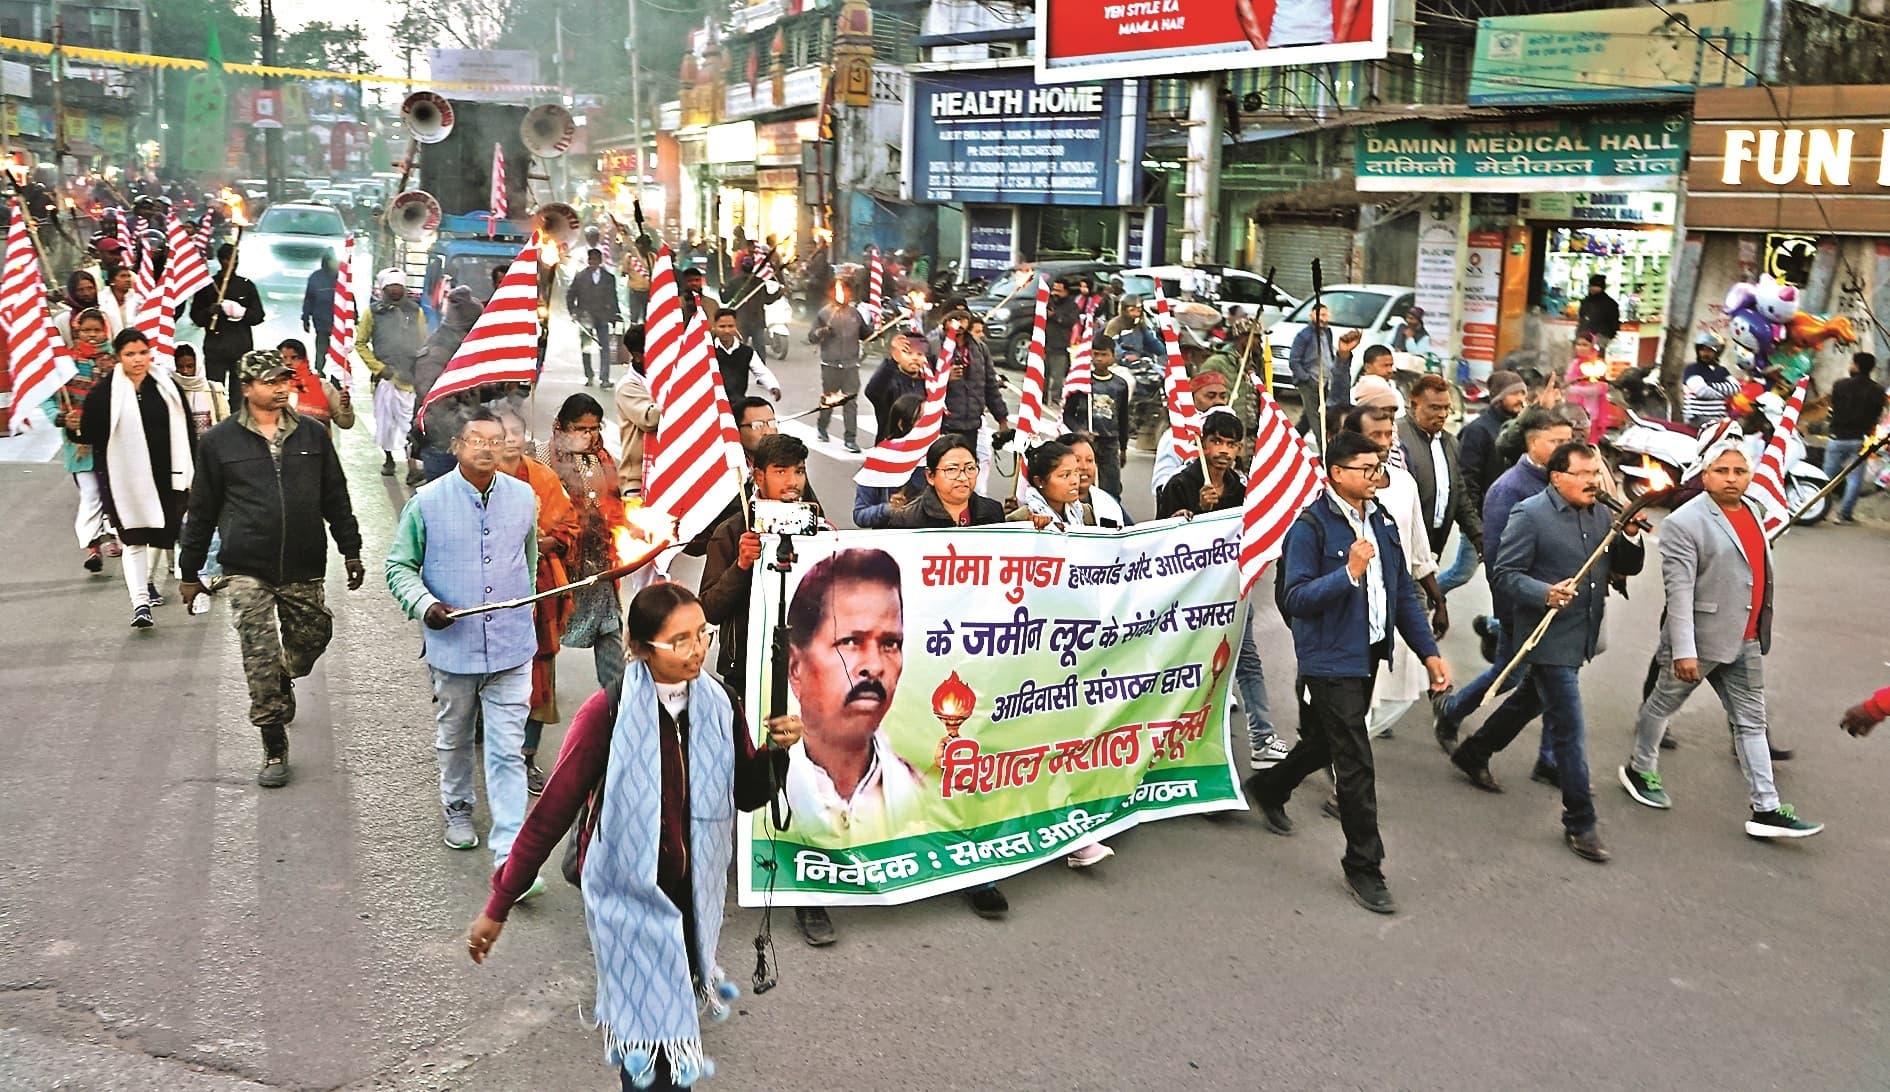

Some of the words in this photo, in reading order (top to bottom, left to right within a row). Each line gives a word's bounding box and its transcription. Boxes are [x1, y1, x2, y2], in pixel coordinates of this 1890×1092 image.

[1104, 5, 1125, 19] YEH
[1127, 1, 1160, 16] STYLE
[1162, 0, 1179, 12] KA
[1118, 20, 1160, 35] MAMLA
[931, 89, 1022, 116] HEALTH
[1028, 86, 1103, 113] HOME
[1367, 138, 1456, 154] DAMINI
[1466, 135, 1590, 153] MEDICAL
[1601, 134, 1679, 151] HALL
[1721, 128, 1856, 186] FUN
[1366, 156, 1456, 175] दामिनी
[1475, 155, 1594, 175] मेडीकल
[1614, 153, 1680, 173] हॉल
[1572, 206, 1616, 219] MEDICAL
[1619, 207, 1643, 220] HALL
[1590, 192, 1628, 205] DAMINI
[922, 543, 992, 587] सोमा
[999, 556, 1065, 604] मुण्डा
[1124, 552, 1152, 582] और
[926, 619, 954, 656] के
[961, 606, 1047, 657] जमीन
[1050, 619, 1101, 667] लूट
[1099, 616, 1119, 648] के
[1159, 600, 1178, 632] में
[1181, 600, 1237, 631] समस्त
[991, 674, 1078, 722] आदिवासी
[1083, 669, 1160, 706] संगठन
[1161, 664, 1202, 695] द्वारा
[941, 739, 1050, 797] विशाल
[1049, 723, 1142, 775] मशाल
[794, 850, 919, 886] निवेदक
[945, 831, 1034, 866] समस्त
